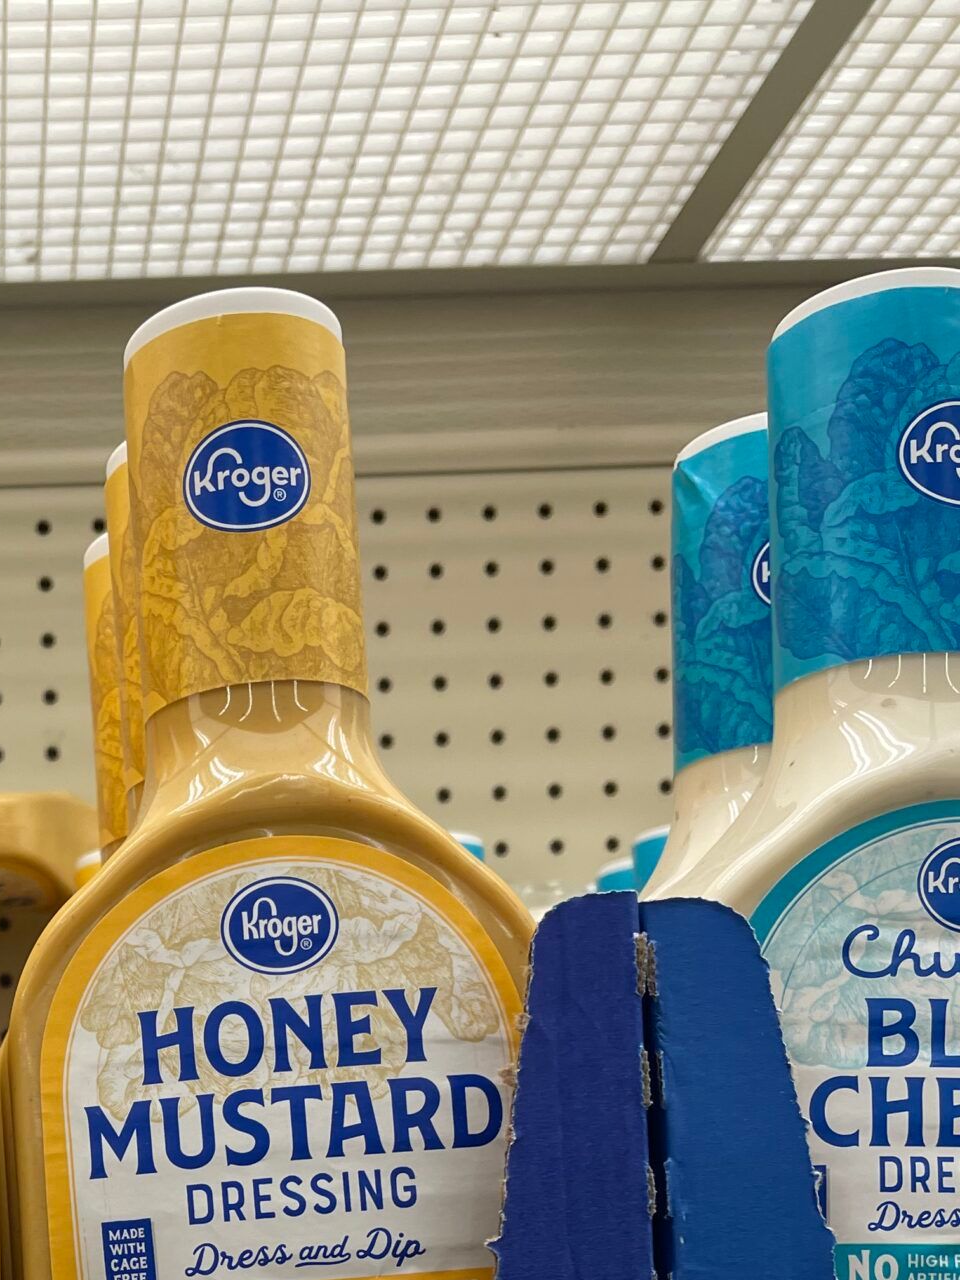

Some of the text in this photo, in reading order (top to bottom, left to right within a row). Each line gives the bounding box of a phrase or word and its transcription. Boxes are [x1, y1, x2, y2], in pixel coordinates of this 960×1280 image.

[193, 447, 302, 508] Kroger
[242, 897, 322, 956] Kroger
[137, 987, 438, 1086] HONEY
[84, 1074, 504, 1180] MUSTARD
[186, 1167, 417, 1225] DRESSING
[108, 1228, 145, 1241] MADE
[109, 1242, 146, 1256] WITH
[185, 1227, 426, 1277] Dress and Dip
[907, 1253, 949, 1268] HIGH
[110, 1257, 148, 1272] CAGE
